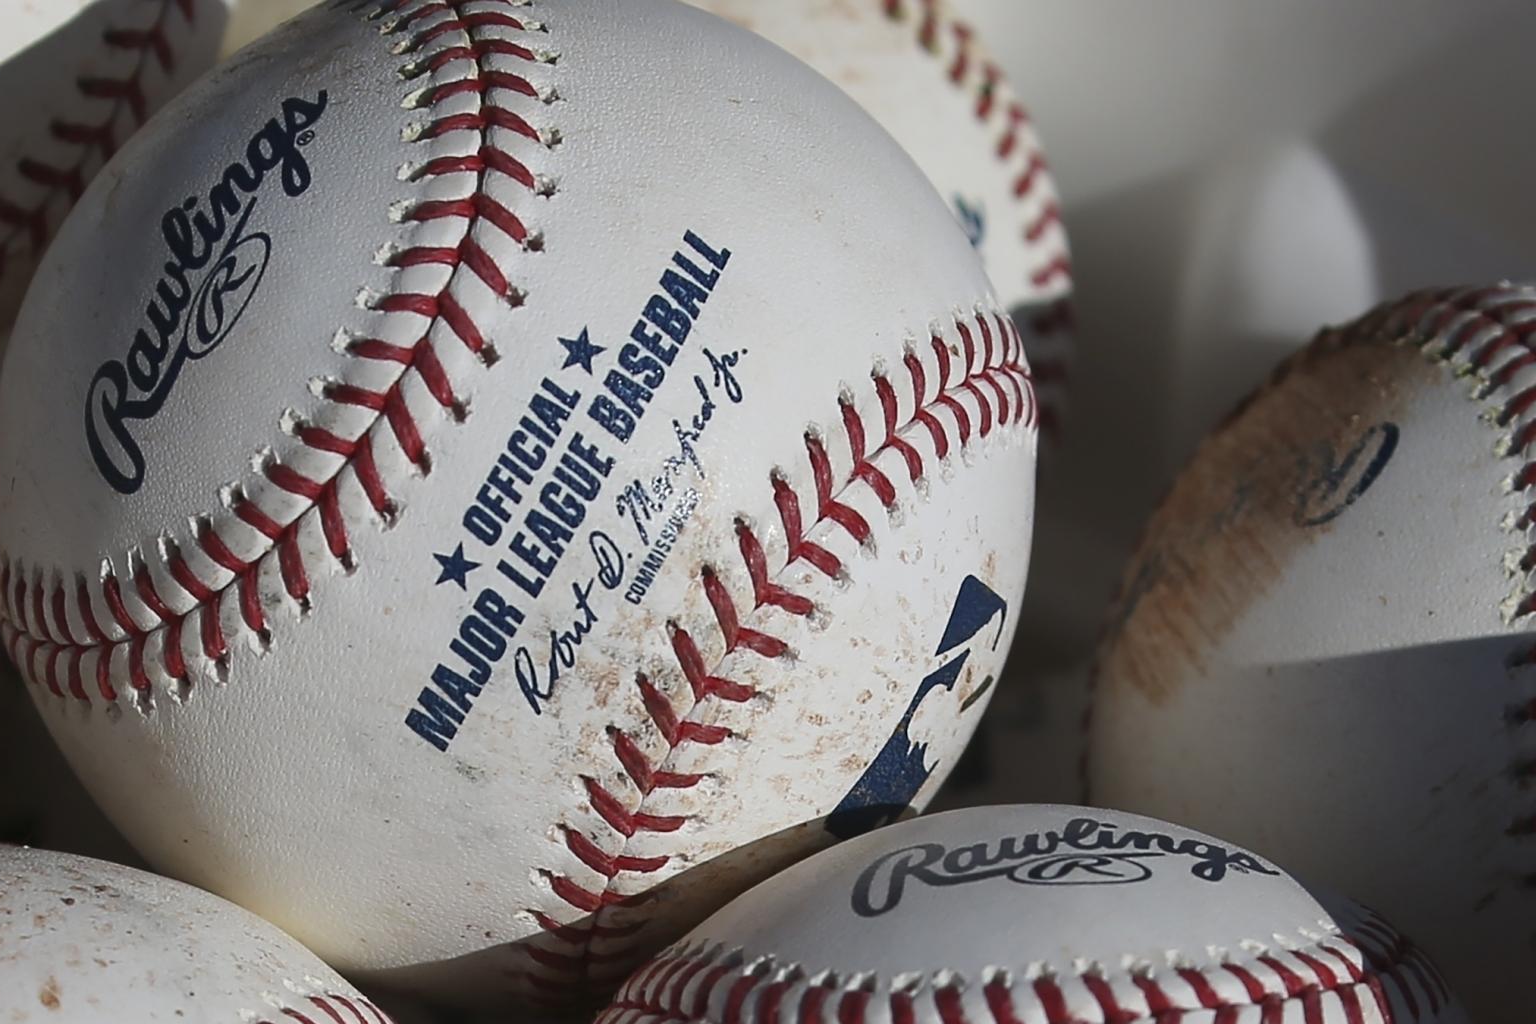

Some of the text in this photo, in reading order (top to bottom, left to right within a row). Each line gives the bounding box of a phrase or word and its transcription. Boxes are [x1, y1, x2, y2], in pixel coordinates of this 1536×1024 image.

[85, 90, 328, 495] Rawlings
[405, 229, 732, 752] MAJOR LEAGUE BASEBALL
[463, 378, 581, 547] OFFICIAL
[851, 818, 1280, 917] Rawlings
